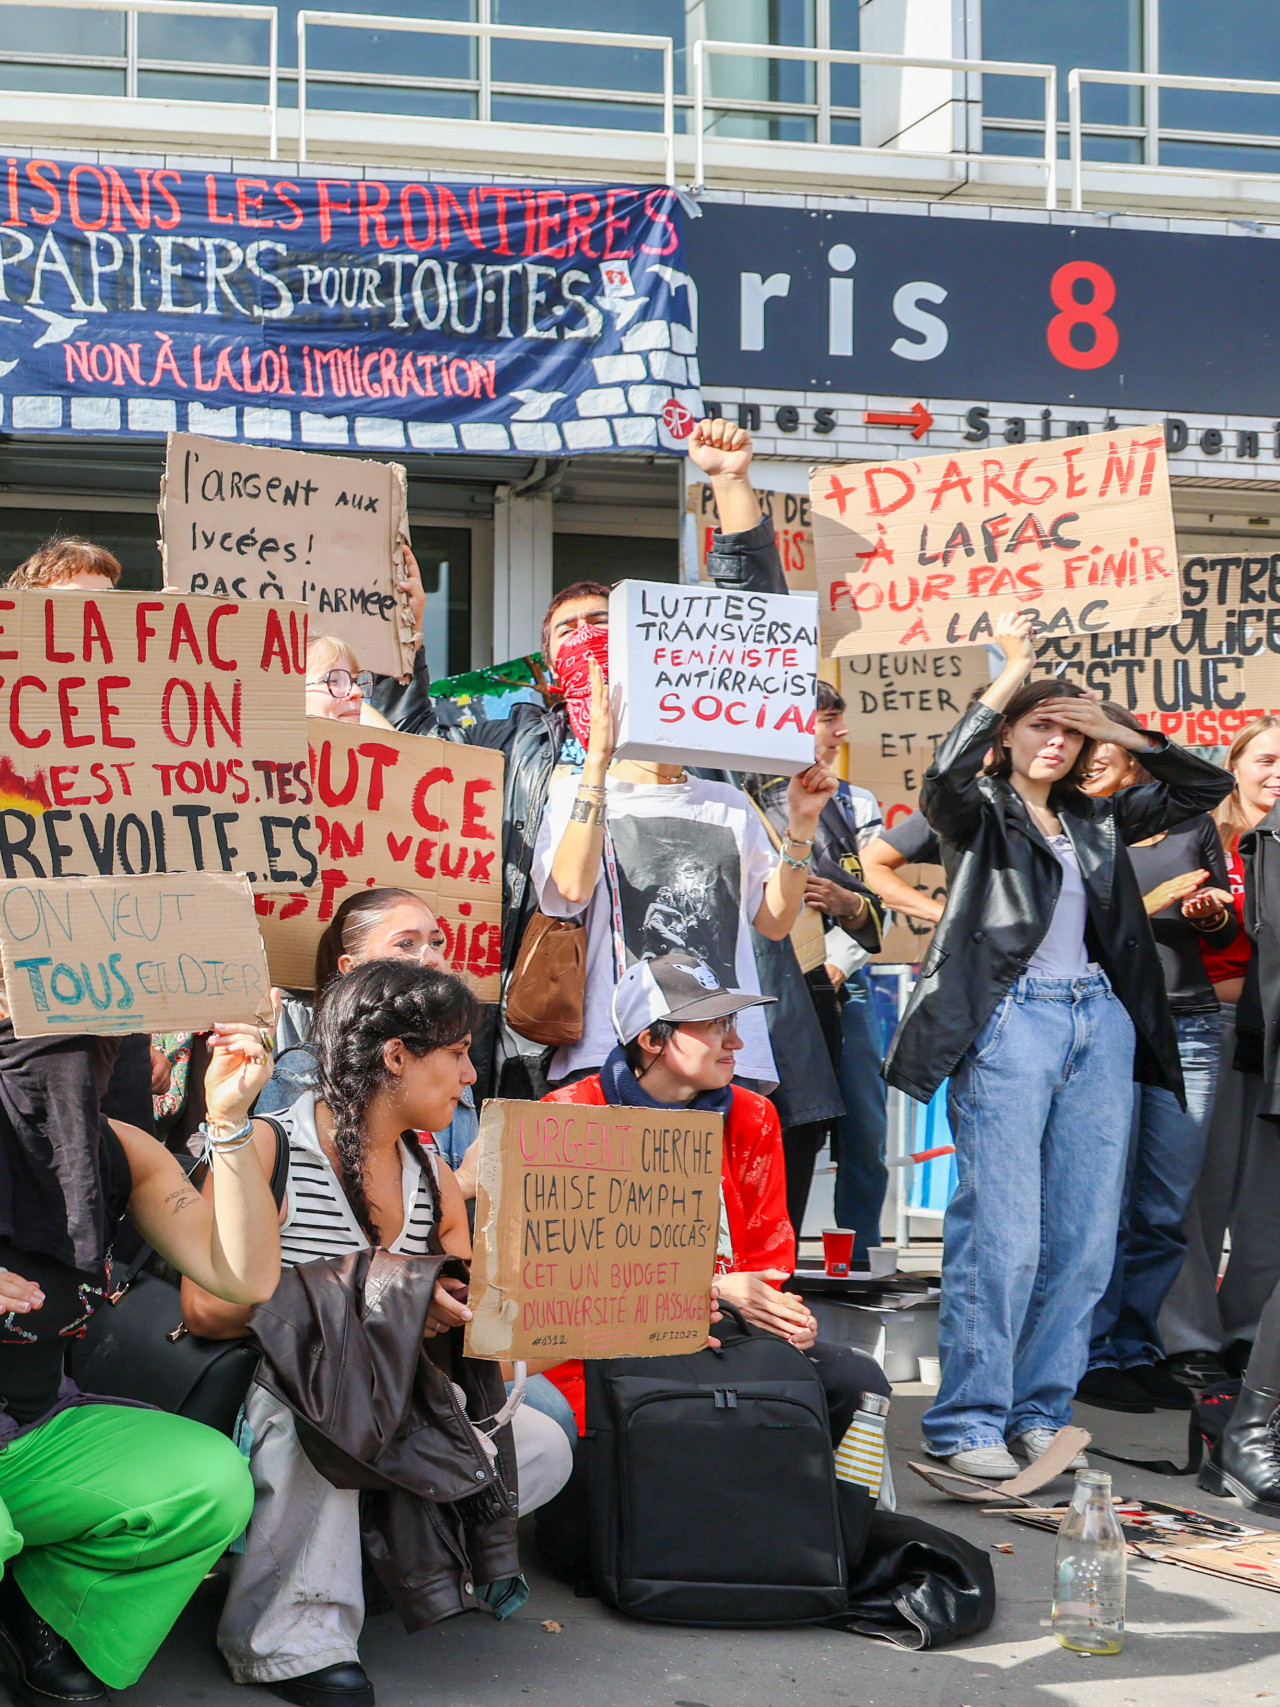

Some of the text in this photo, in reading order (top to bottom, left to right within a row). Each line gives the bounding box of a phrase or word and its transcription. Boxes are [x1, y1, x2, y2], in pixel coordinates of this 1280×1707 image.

[205, 173, 304, 230] LES
[297, 263, 386, 310] POUR
[1046, 260, 1119, 370] 8
[63, 341, 146, 387] NON
[149, 331, 187, 389] À
[193, 345, 243, 393] LA
[863, 436, 1166, 517] D'ARGENT
[917, 520, 975, 567] LA
[980, 512, 1081, 563] FAC
[641, 589, 769, 622] LUTTES
[829, 572, 956, 612] POUR
[968, 561, 1045, 602] PAS
[44, 598, 114, 665] LA
[136, 601, 240, 672] FAC
[260, 608, 308, 676] AU
[946, 610, 993, 644] LA
[849, 653, 963, 678] JEUNES
[160, 677, 244, 750] ON
[858, 682, 960, 714] DÉTER
[881, 732, 917, 758] ET
[49, 760, 136, 807] EST
[411, 766, 496, 841] CE
[387, 831, 496, 884] VEUX
[3, 886, 73, 948] ON
[90, 888, 195, 942] VEUT
[13, 952, 269, 1012] TOUS ETUDIER
[641, 1127, 715, 1178] CHERCHE
[523, 1172, 596, 1212] CHAISE
[523, 1217, 606, 1257] NEUVE
[615, 1220, 641, 1249] OU
[570, 1260, 599, 1291] UN
[611, 1261, 681, 1290] BUDGET
[634, 1293, 649, 1324] AU
